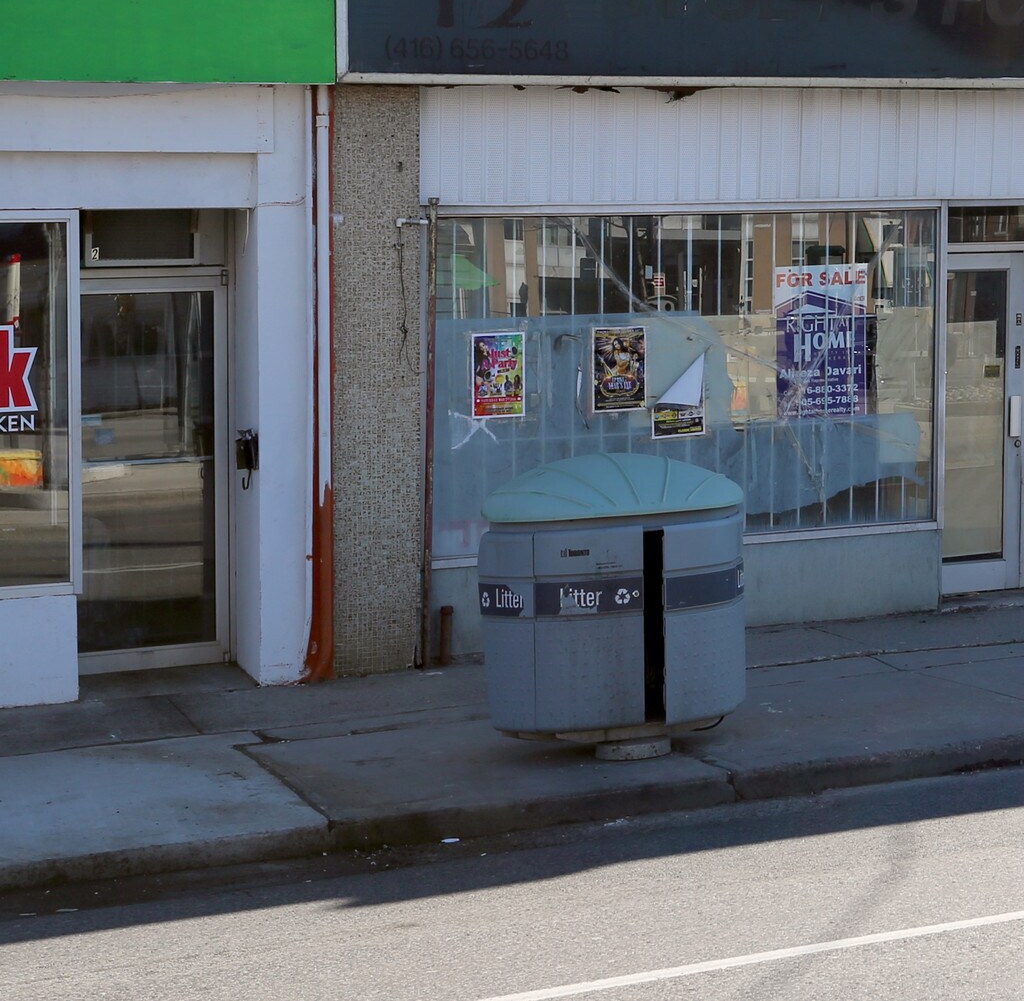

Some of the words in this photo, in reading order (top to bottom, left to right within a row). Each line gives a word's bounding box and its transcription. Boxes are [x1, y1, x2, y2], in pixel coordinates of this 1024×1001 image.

[385, 34, 442, 61] (416)
[449, 37, 569, 61] 656-5648
[91, 248, 99, 261] 2
[776, 273, 813, 288] FOR
[819, 270, 866, 286] SALE
[786, 315, 838, 333] RGHT
[490, 348, 512, 359] Just
[793, 332, 855, 363] HOME
[490, 359, 518, 371] Party
[779, 368, 820, 380] Alieza
[826, 364, 862, 376] Davari
[799, 384, 859, 395] 16-880-3372
[799, 395, 859, 406] 05-695-7888
[496, 588, 523, 609] Litter
